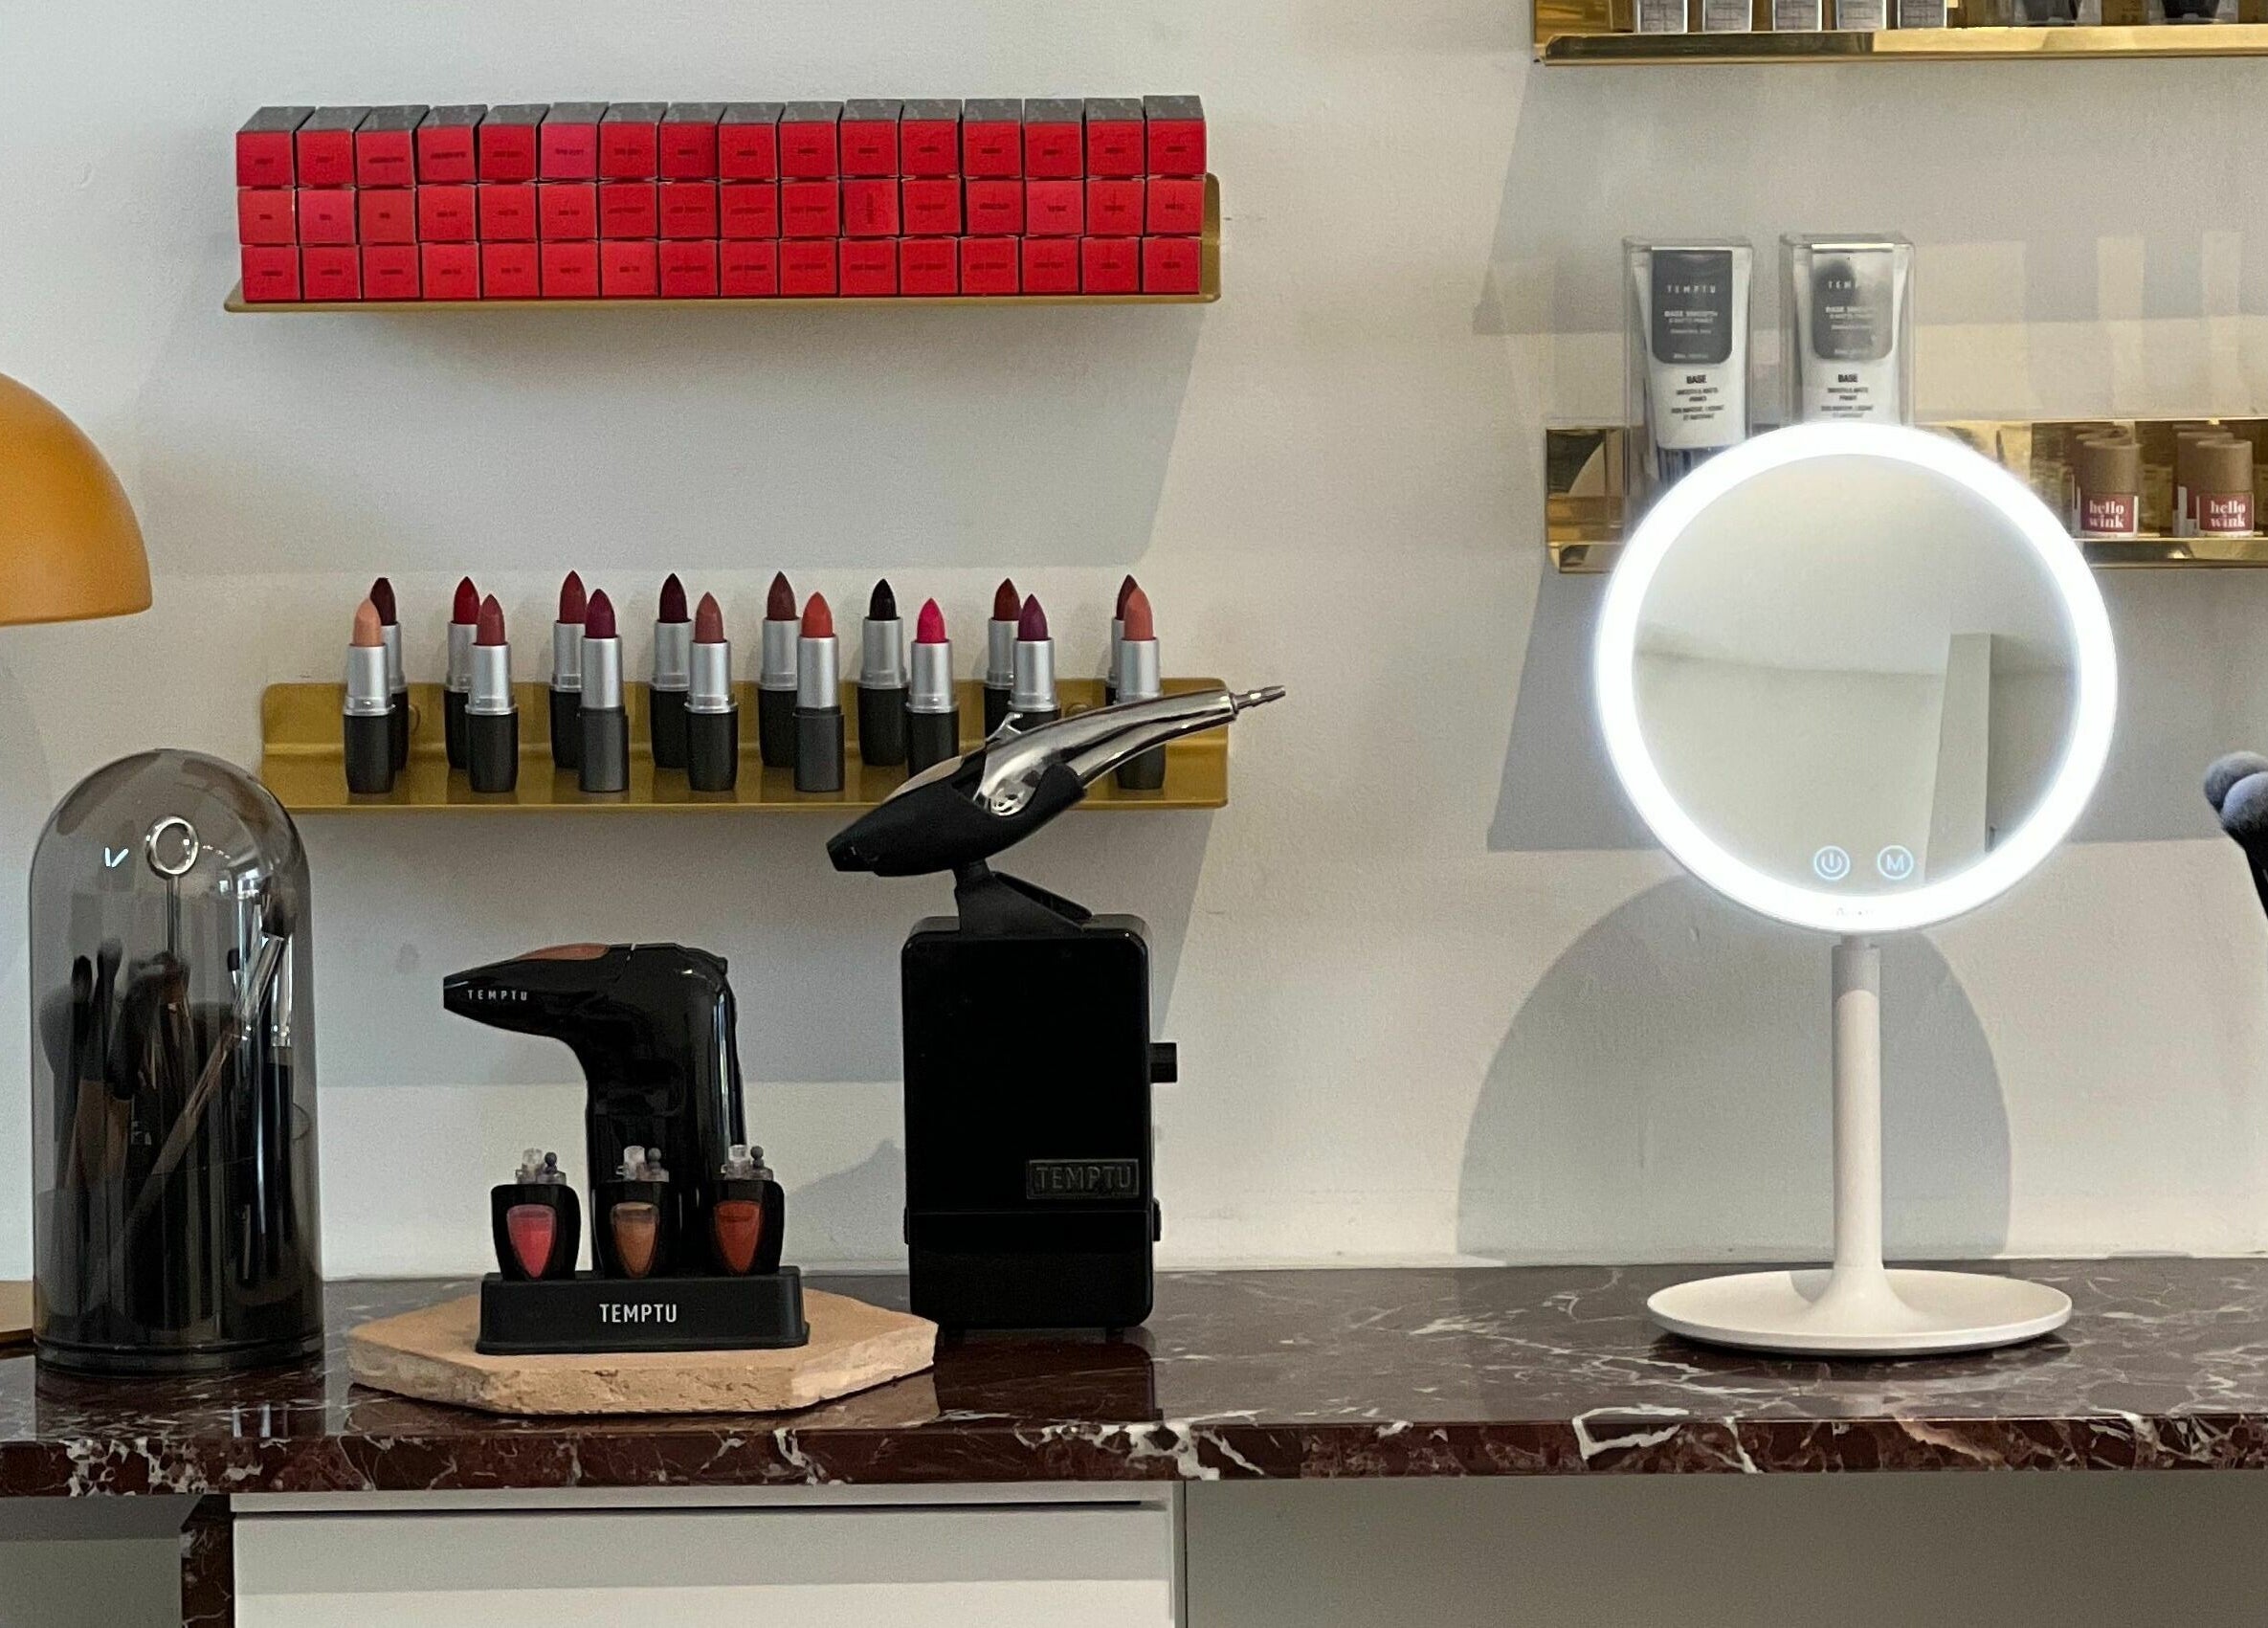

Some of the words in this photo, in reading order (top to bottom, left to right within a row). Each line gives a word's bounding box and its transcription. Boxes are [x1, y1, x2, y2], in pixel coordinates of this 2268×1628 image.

[1667, 284, 1716, 294] TEMPTU
[1686, 374, 1707, 385] BASE
[1837, 373, 1858, 383] BASE
[2089, 500, 2124, 515] hello
[2211, 500, 2246, 515] hello
[2089, 515, 2124, 528] wink
[2211, 514, 2246, 528] wink
[467, 990, 528, 1001] TEMPTU
[1035, 1166, 1131, 1189] TEMPTU
[599, 1303, 678, 1324] TEMPTU
